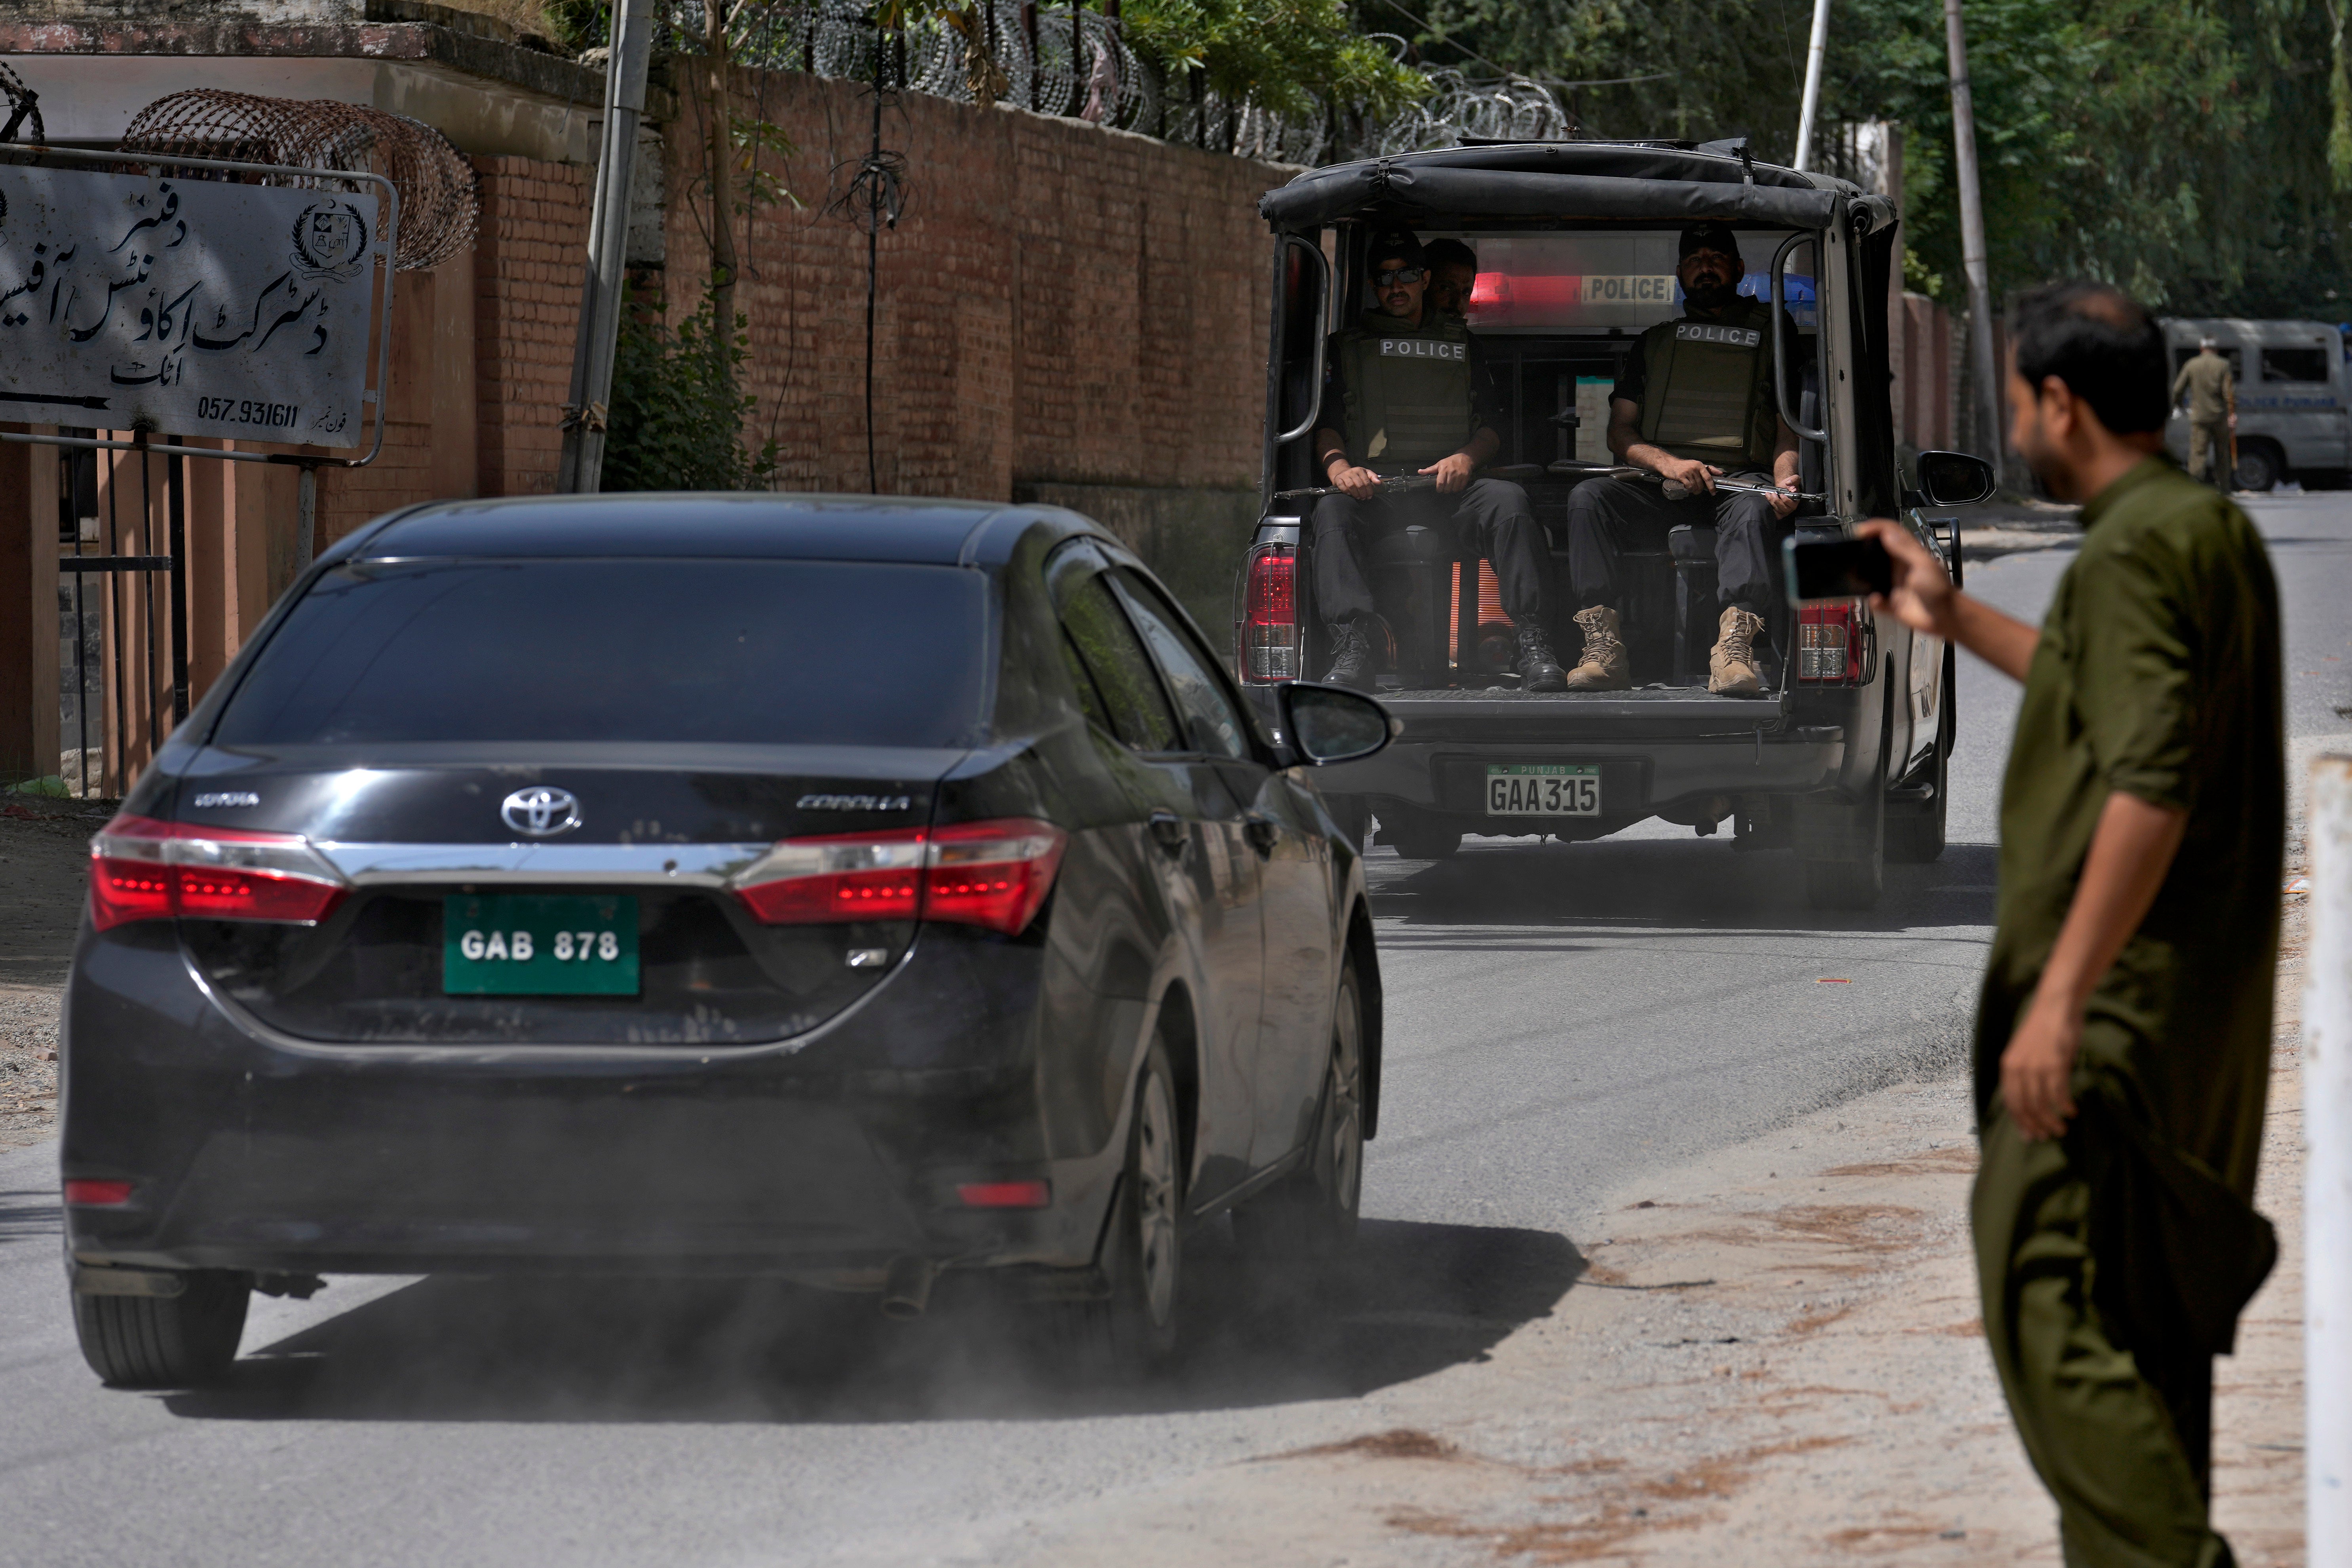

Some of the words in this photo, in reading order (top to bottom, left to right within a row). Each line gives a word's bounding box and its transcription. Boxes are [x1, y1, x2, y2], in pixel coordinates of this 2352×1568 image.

[106, 182, 186, 252] دفتر
[1591, 278, 1665, 299] POLICE
[192, 270, 328, 354] ڈسٹرکٹ
[1676, 325, 1758, 346] POLICE
[1383, 341, 1462, 359] POLICE
[325, 412, 347, 432] فون
[1521, 766, 1565, 774] PUNJAB
[796, 794, 910, 810] COROLLA
[461, 929, 534, 960] GAB
[554, 930, 619, 961] 878
